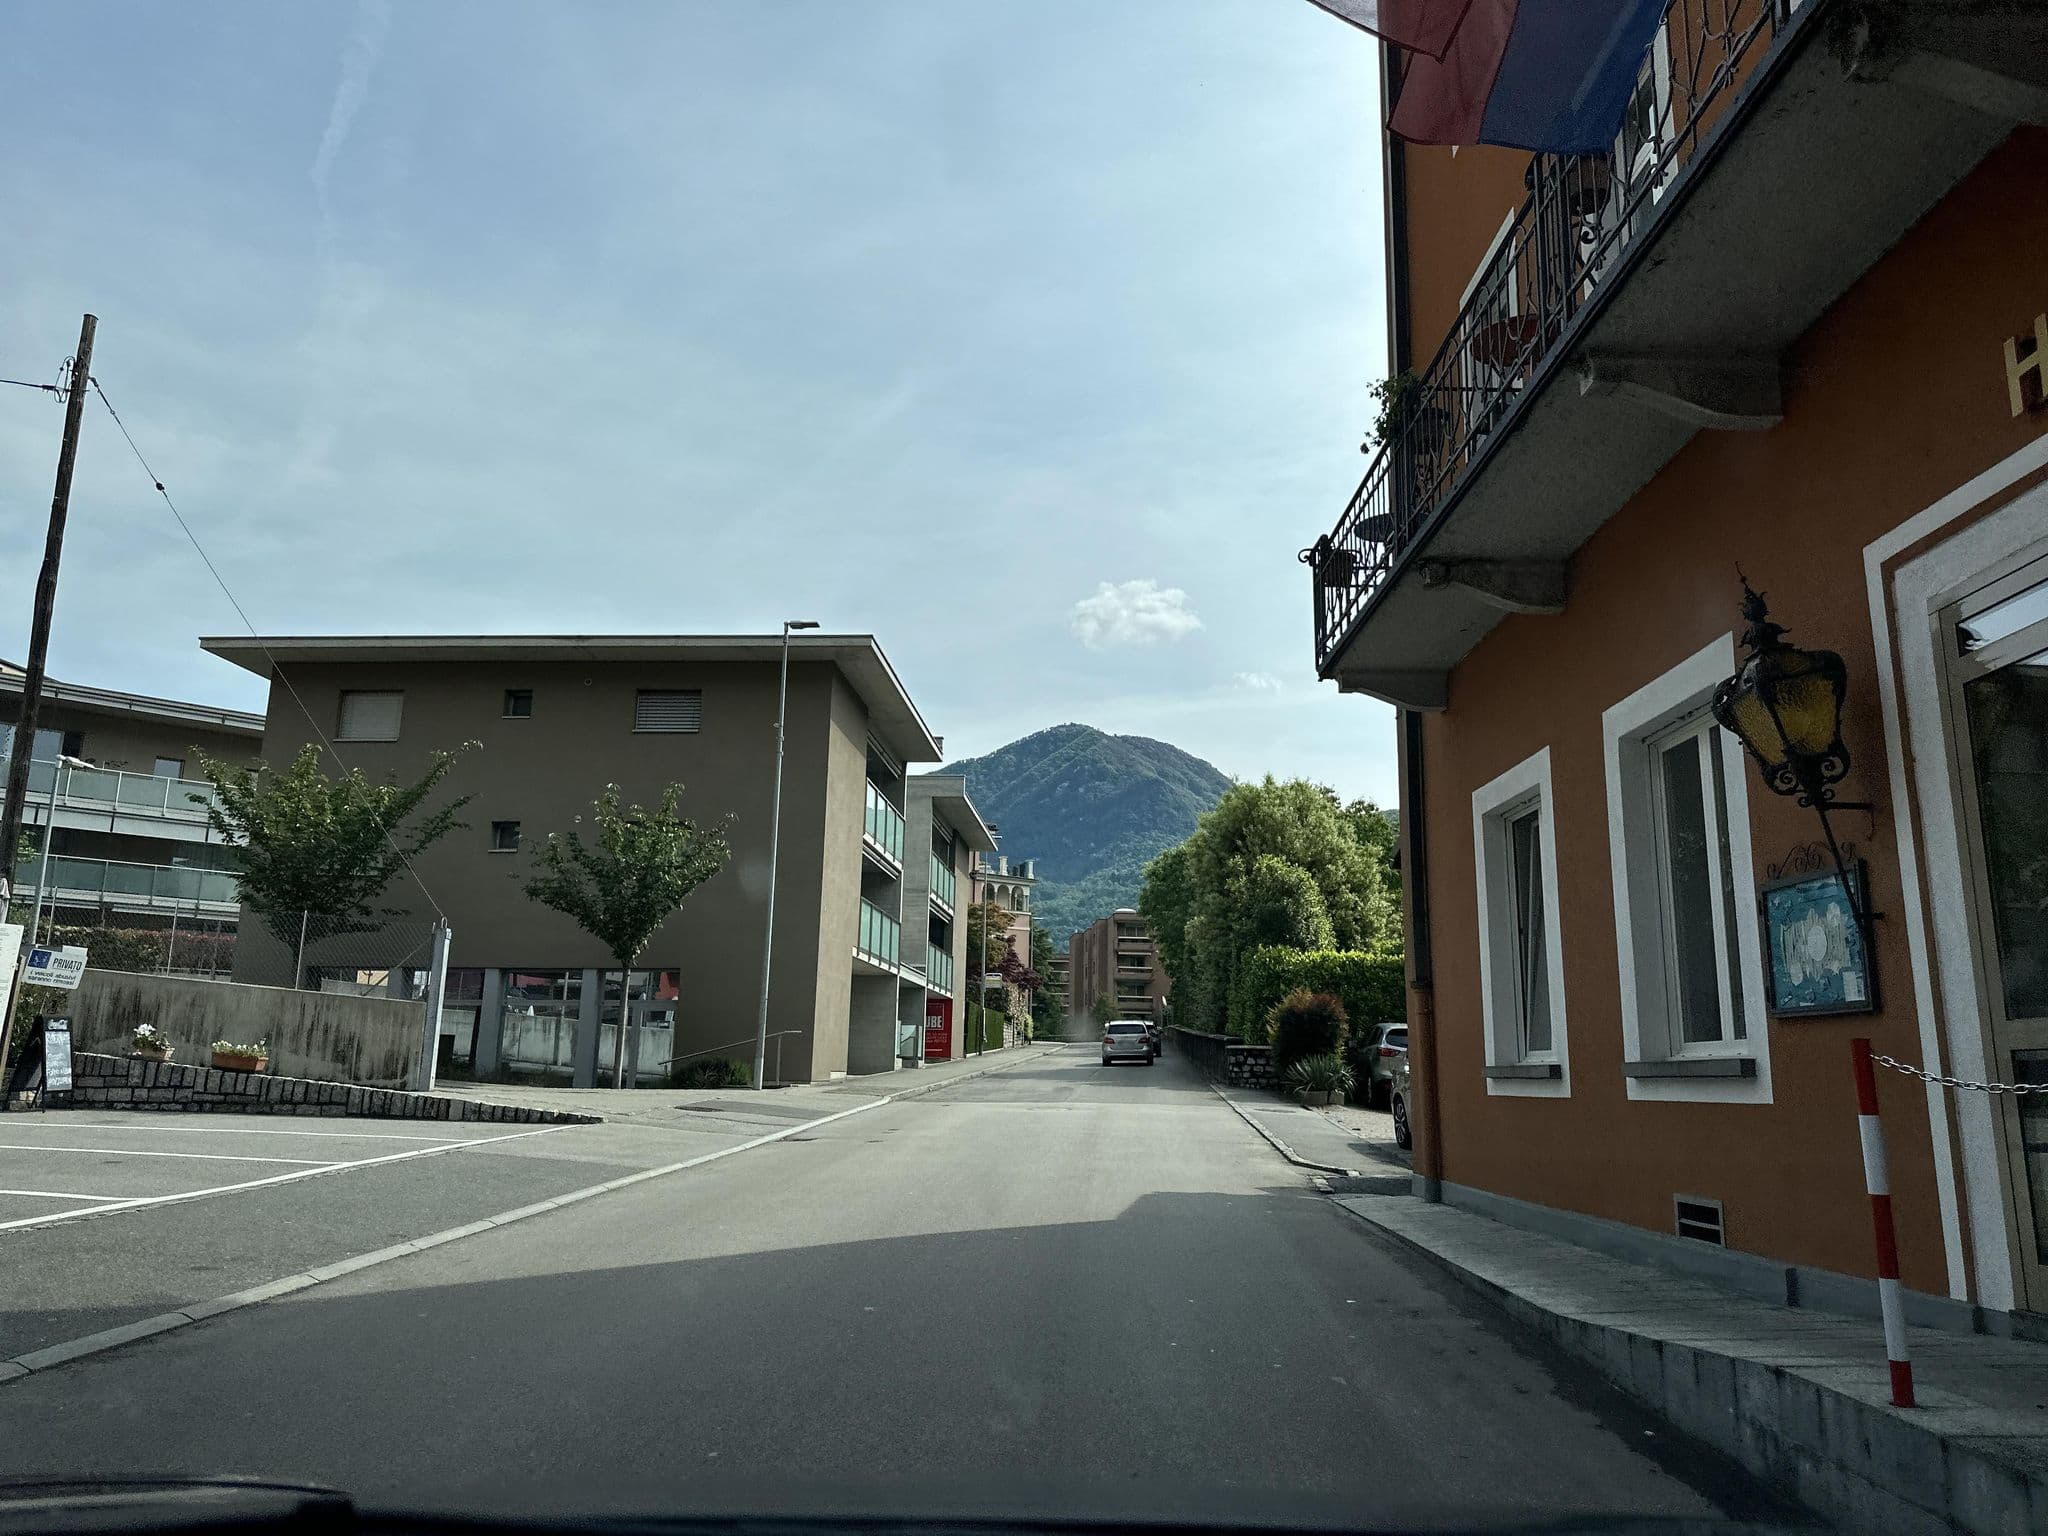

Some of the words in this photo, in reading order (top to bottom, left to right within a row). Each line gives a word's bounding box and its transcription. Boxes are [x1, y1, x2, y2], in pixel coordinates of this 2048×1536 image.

[2003, 312, 2048, 418] H
[52, 957, 83, 971] PRIVATO
[27, 975, 52, 983] saranno
[52, 978, 75, 986] rimossi
